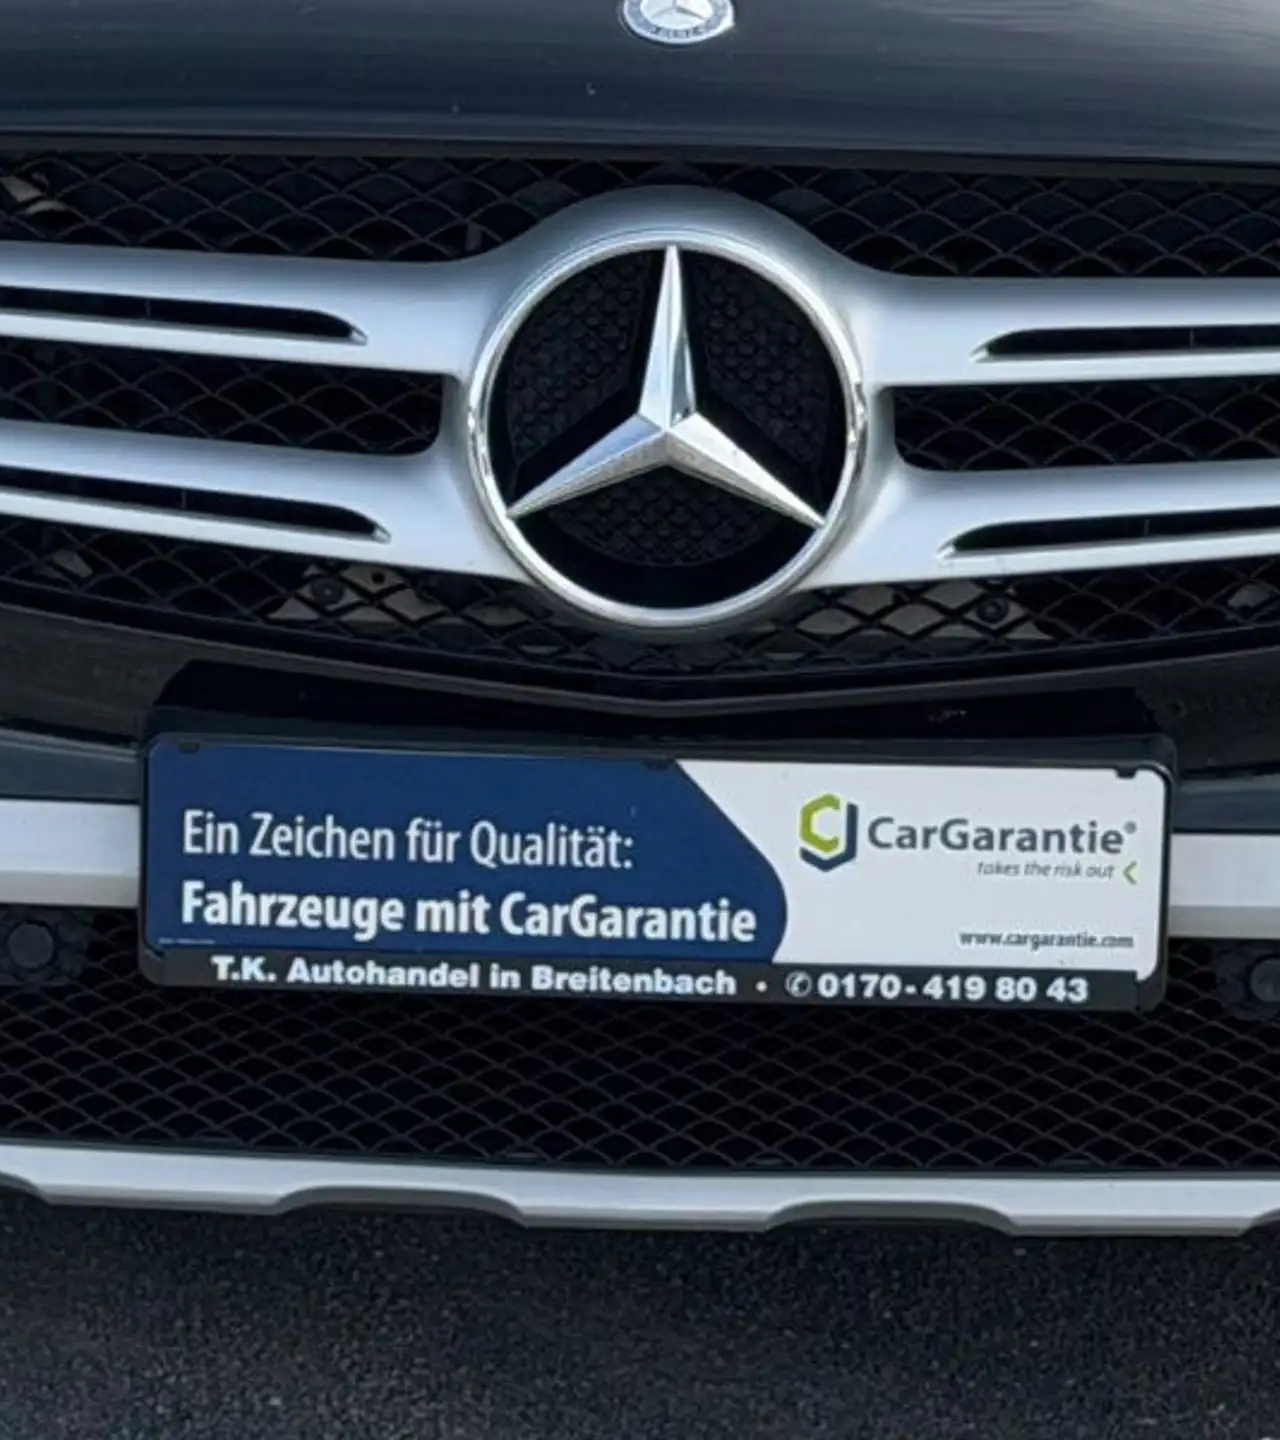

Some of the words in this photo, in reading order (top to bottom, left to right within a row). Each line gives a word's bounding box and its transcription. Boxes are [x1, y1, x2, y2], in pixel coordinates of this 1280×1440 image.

[182, 809, 239, 855] Ein
[249, 812, 396, 861] Zeichen
[406, 817, 462, 863] für
[470, 820, 634, 869] Qualität:
[977, 861, 1020, 877] takes
[1023, 863, 1053, 878] the
[1053, 862, 1083, 878] risk
[1086, 865, 1116, 879] out
[181, 879, 405, 942] Fahrzeuge
[416, 889, 491, 935] mit
[499, 891, 758, 942] CarGarantie
[959, 930, 1134, 952] www.cargarantie.com
[210, 955, 277, 982] T.K.
[286, 956, 481, 988] Autohandel
[488, 963, 520, 989] in
[531, 964, 736, 995] Breitenbach
[994, 975, 1037, 1001] 80
[1045, 976, 1089, 1003] 43
